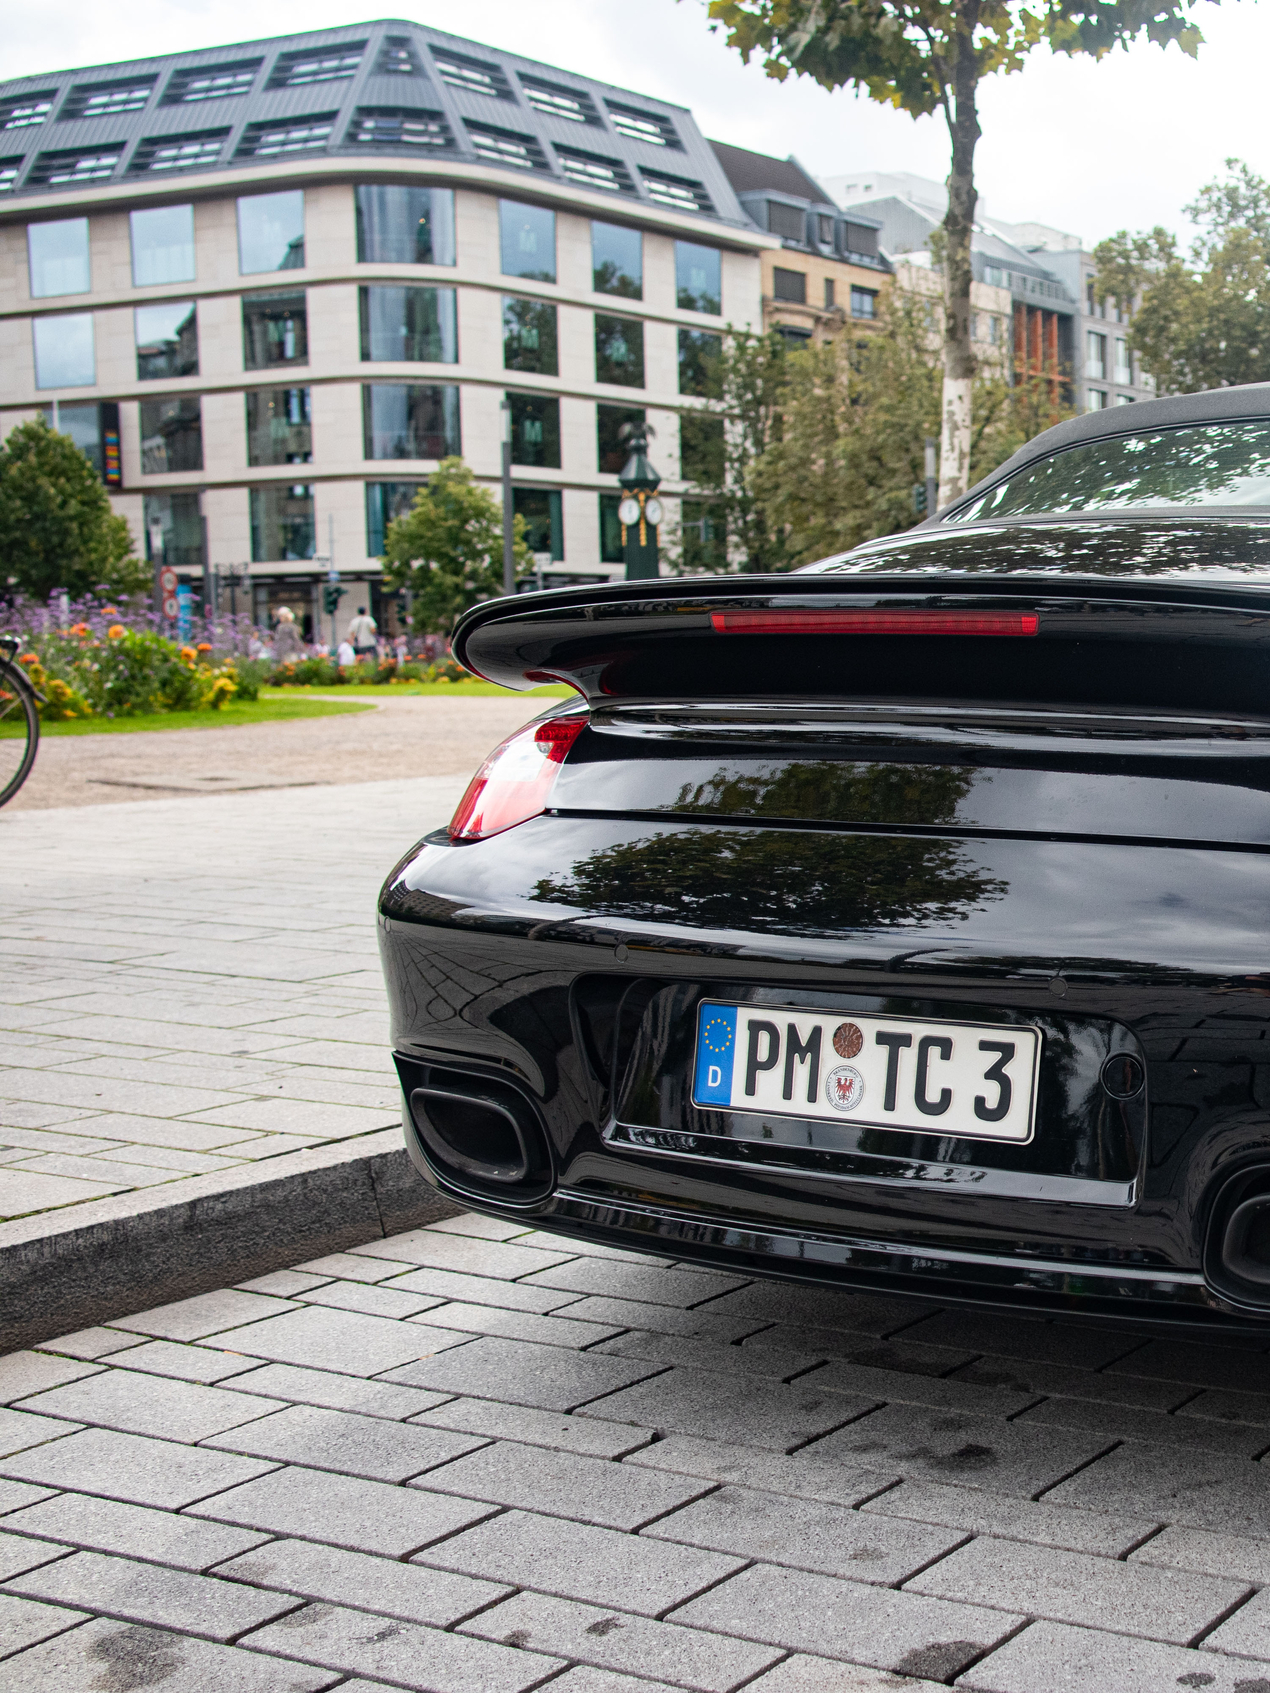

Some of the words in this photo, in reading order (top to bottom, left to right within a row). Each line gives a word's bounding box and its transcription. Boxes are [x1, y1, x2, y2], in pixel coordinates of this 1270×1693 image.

[707, 1065, 722, 1088] D
[744, 1018, 823, 1104] PM
[875, 1030, 954, 1117] TC
[974, 1039, 1016, 1122] 3
